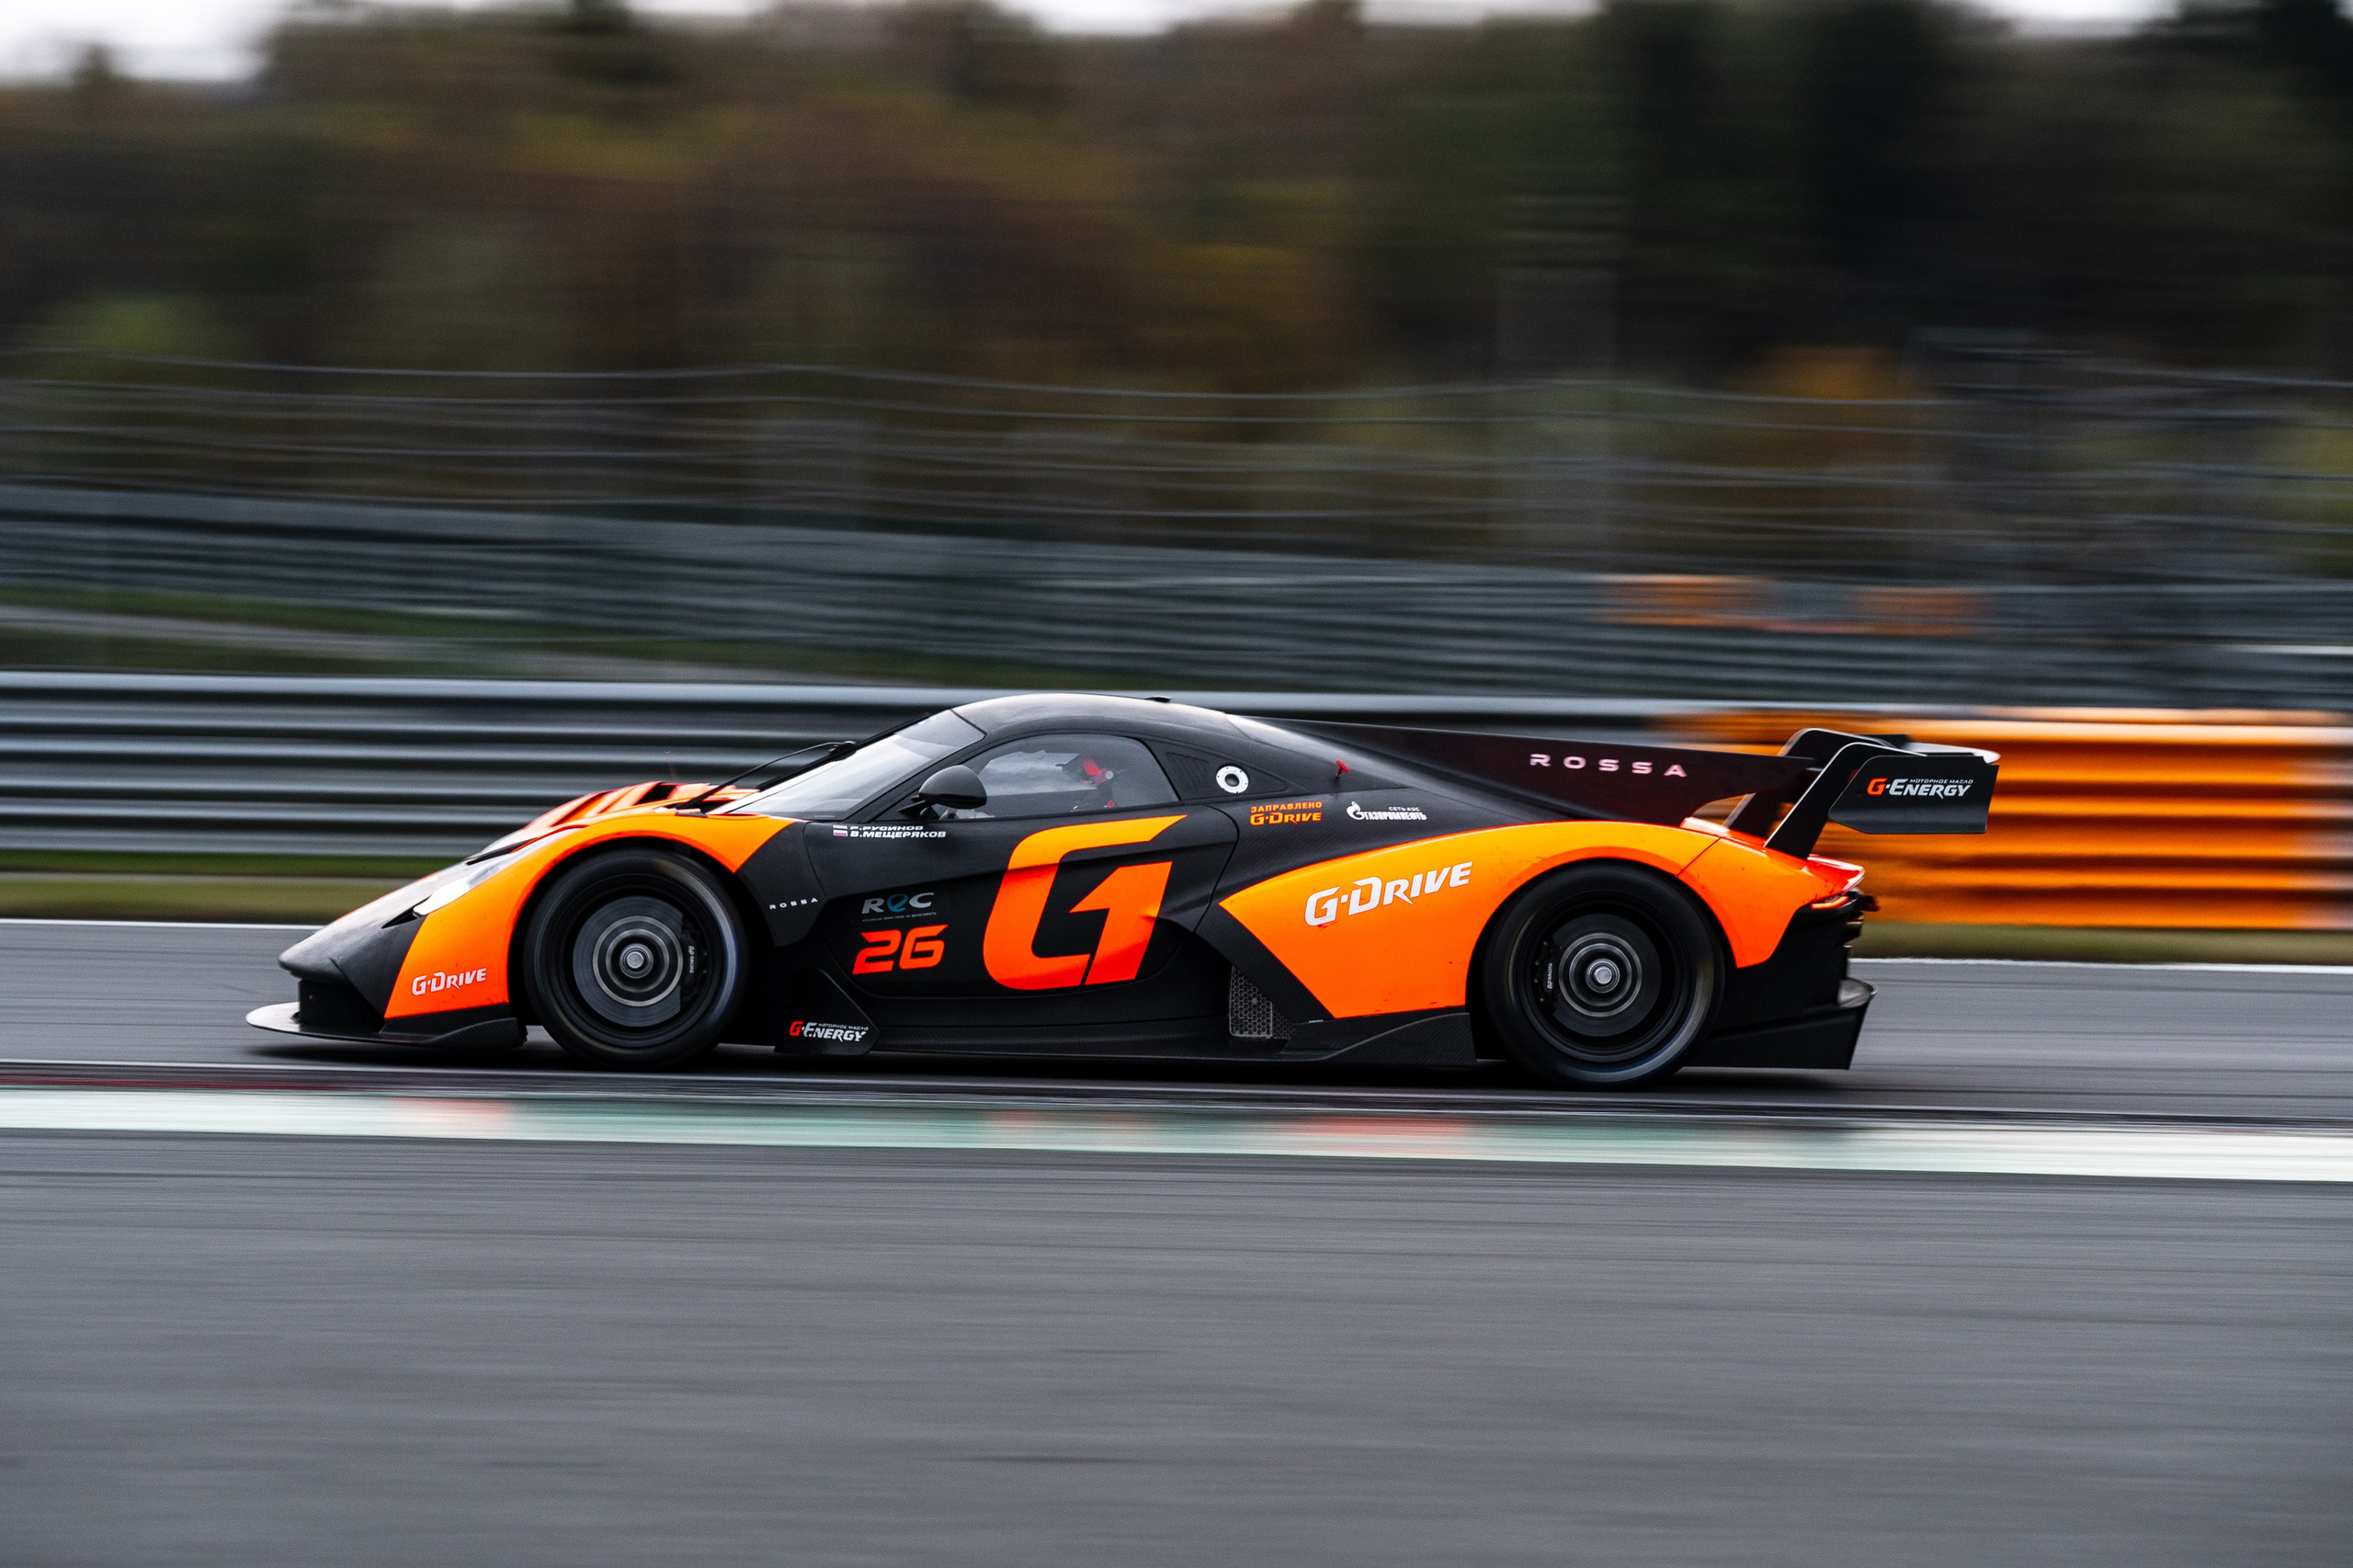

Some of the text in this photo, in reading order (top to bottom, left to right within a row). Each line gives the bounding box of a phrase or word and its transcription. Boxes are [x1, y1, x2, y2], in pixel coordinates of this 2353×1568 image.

[1529, 754, 1688, 778] ROSSA
[1250, 801, 1323, 813] ЗАПРАВЛЕНО
[849, 831, 947, 839] В.МЕЩЕРЯКОВ
[769, 897, 818, 910] ROSSA
[852, 924, 949, 975] 26
